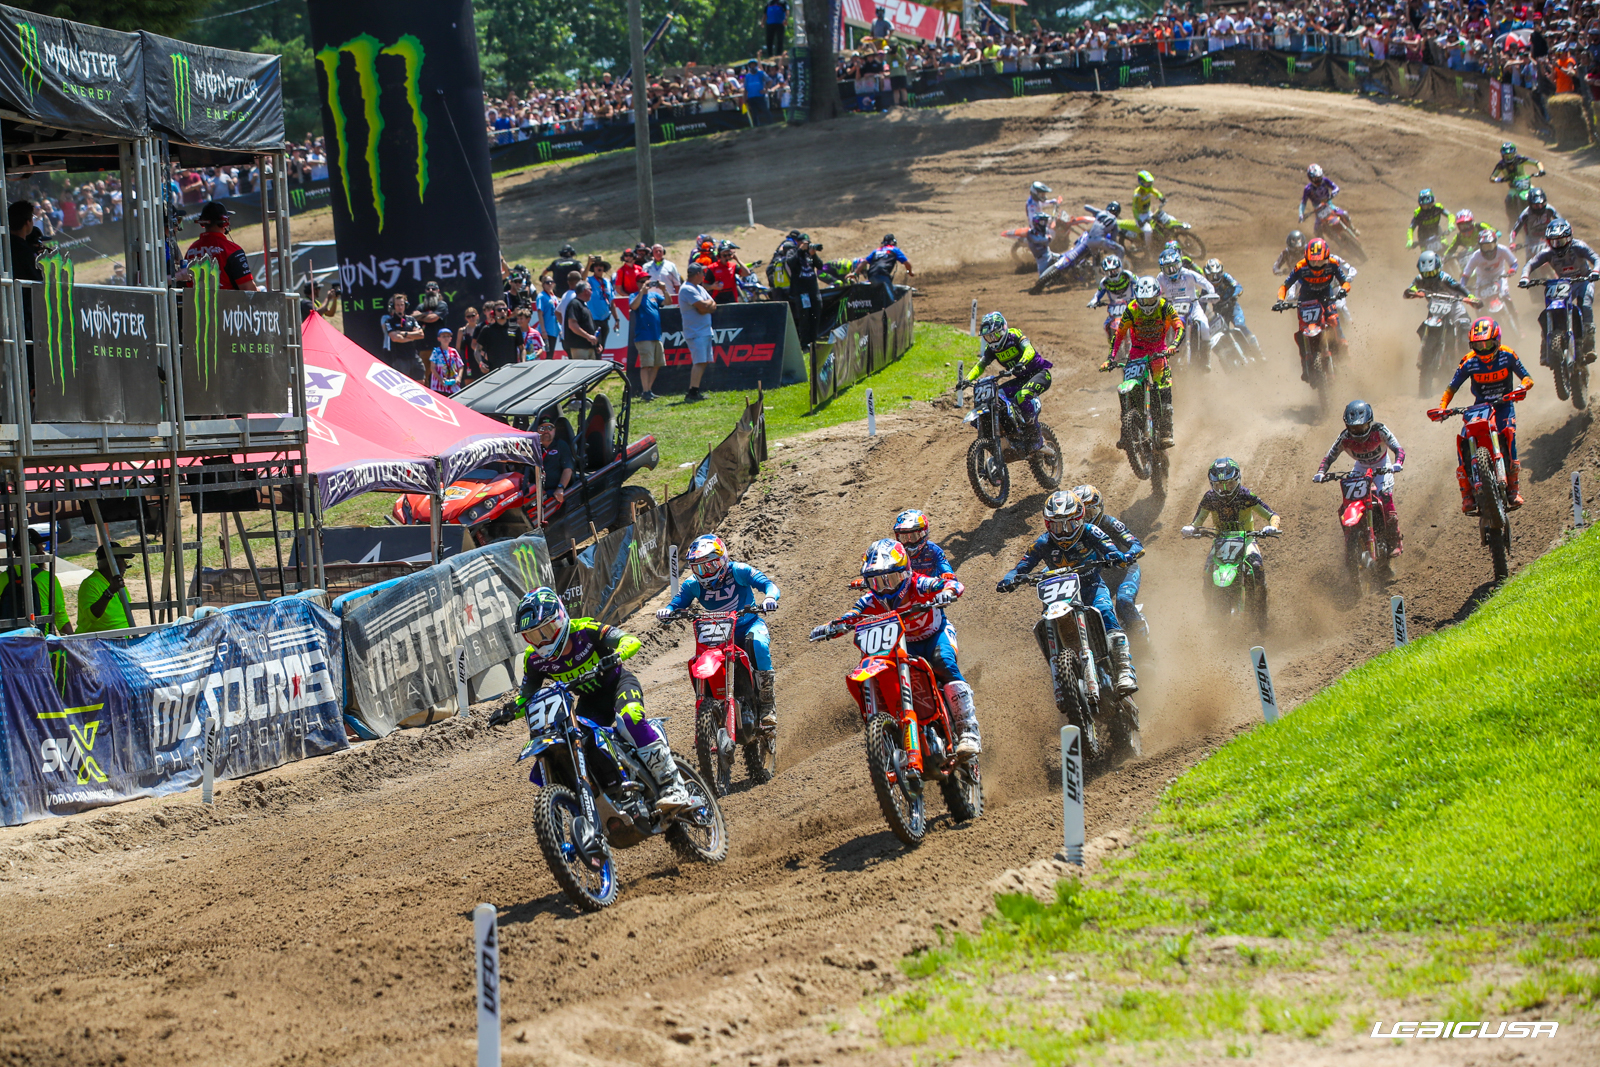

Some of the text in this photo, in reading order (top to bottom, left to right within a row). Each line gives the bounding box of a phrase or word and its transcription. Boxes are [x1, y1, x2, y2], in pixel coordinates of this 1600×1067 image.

[894, 24, 917, 35] CING
[43, 39, 121, 82] MONSTER
[62, 81, 112, 101] ENERGY
[194, 67, 262, 103] MONSTER
[206, 107, 252, 122] ENERGY
[675, 122, 707, 133] MONSTER
[551, 140, 584, 150] MONSTER
[343, 290, 459, 313] ENEY
[1545, 283, 1570, 298] 42
[1302, 308, 1321, 323] 57
[1429, 302, 1452, 316] 575
[80, 302, 148, 340] MONSTER
[222, 304, 281, 338] MONSTER
[93, 344, 139, 359] ENERGY
[231, 342, 275, 354] ENERGY
[634, 343, 776, 368] EGNDS
[1124, 365, 1147, 381] 290
[1344, 480, 1368, 499] 73
[1574, 485, 1582, 507] UFO
[1217, 541, 1243, 559] 47
[704, 584, 736, 602] FLY
[1043, 580, 1077, 604] 34
[698, 624, 732, 643] 29
[857, 623, 899, 654] 109
[1394, 614, 1405, 643] UFO
[217, 633, 268, 662] PRO
[459, 663, 467, 686] UFO
[901, 675, 912, 705] WP
[1256, 670, 1273, 705] UFO
[528, 694, 564, 730] 37
[206, 735, 216, 764] UFO
[1065, 756, 1076, 802] UFO
[46, 792, 74, 807] WORLD
[581, 786, 595, 823] DUNLOP
[482, 950, 497, 1018] UFO
